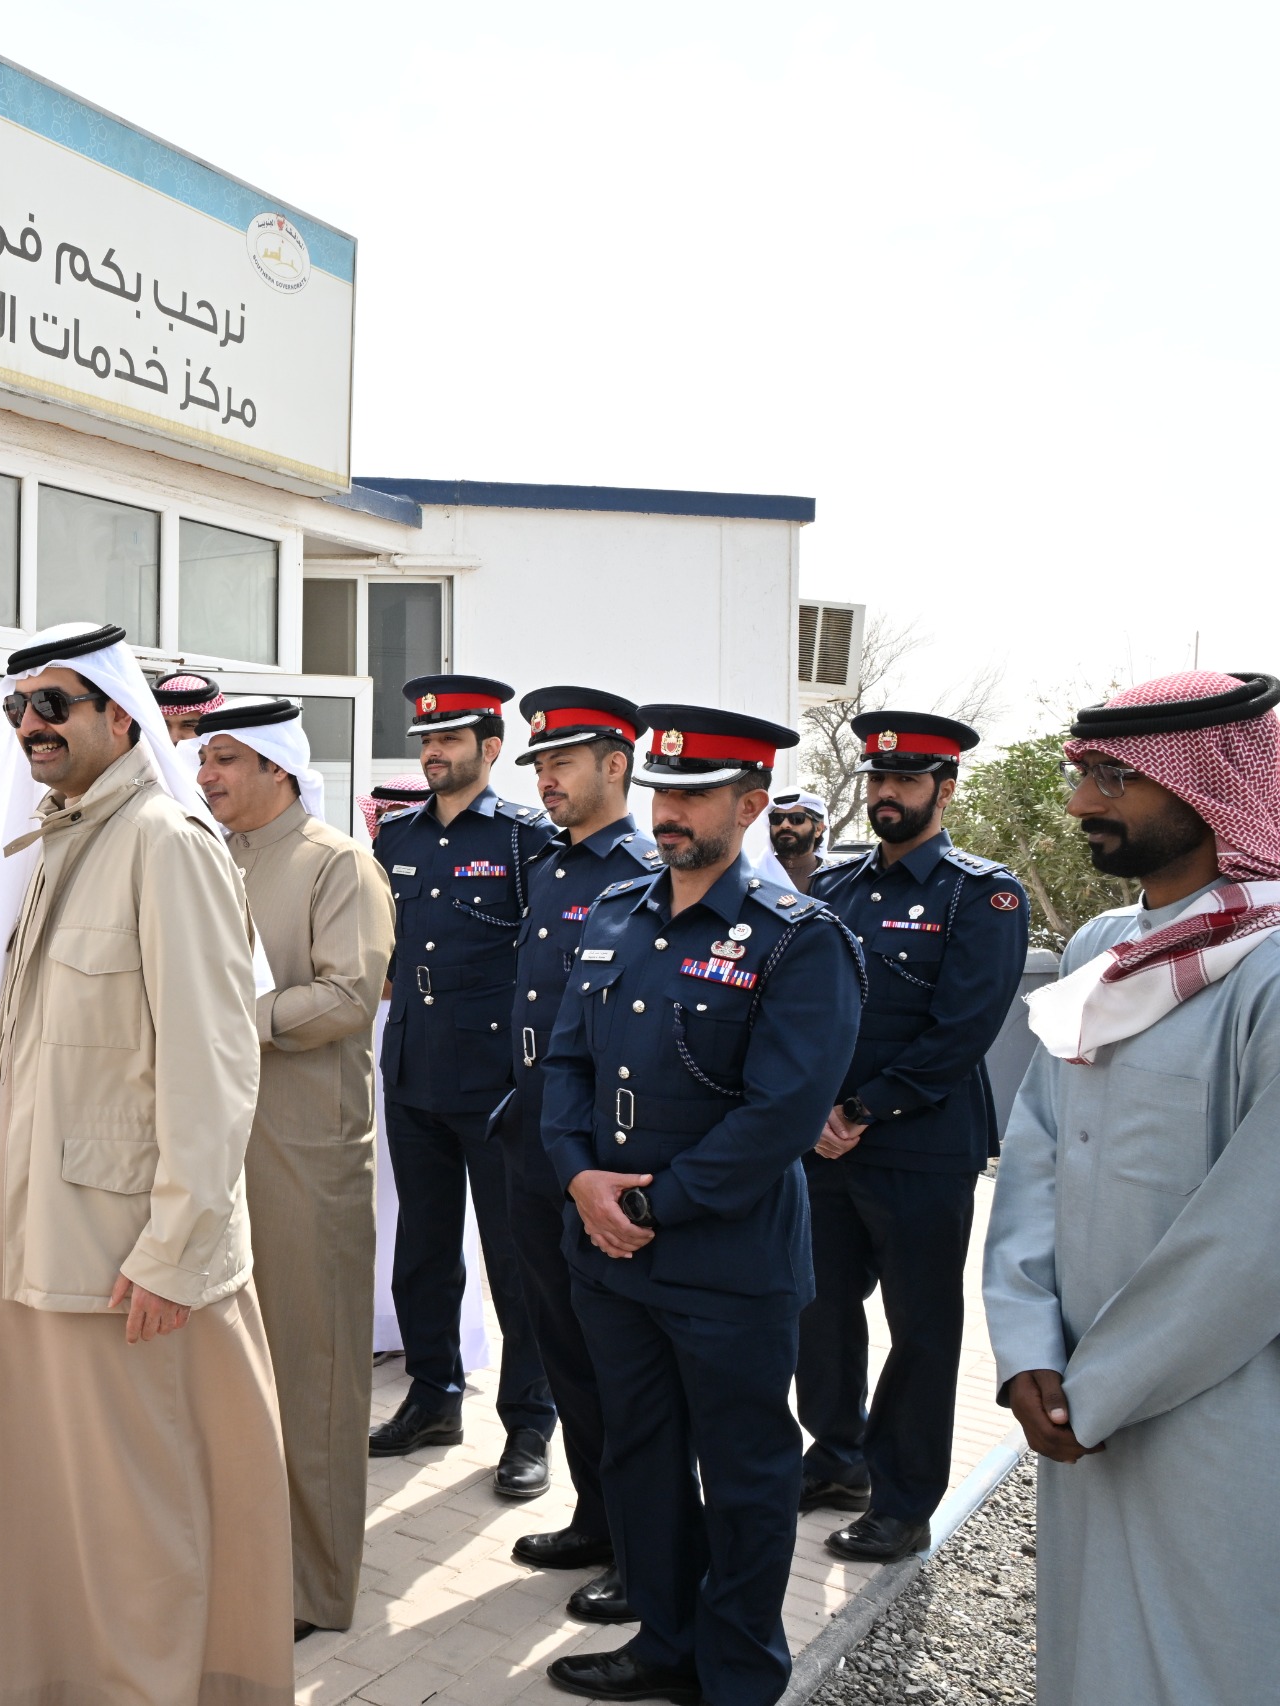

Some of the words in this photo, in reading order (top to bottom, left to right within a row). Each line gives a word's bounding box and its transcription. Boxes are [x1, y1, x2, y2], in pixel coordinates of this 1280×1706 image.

[55, 242, 142, 319] بكم
[252, 254, 275, 284] SOUTHERN
[275, 276, 307, 290] GOVERNORATE
[153, 279, 246, 347] نرحب
[30, 313, 169, 395] خدمات
[180, 358, 257, 429] مركز
